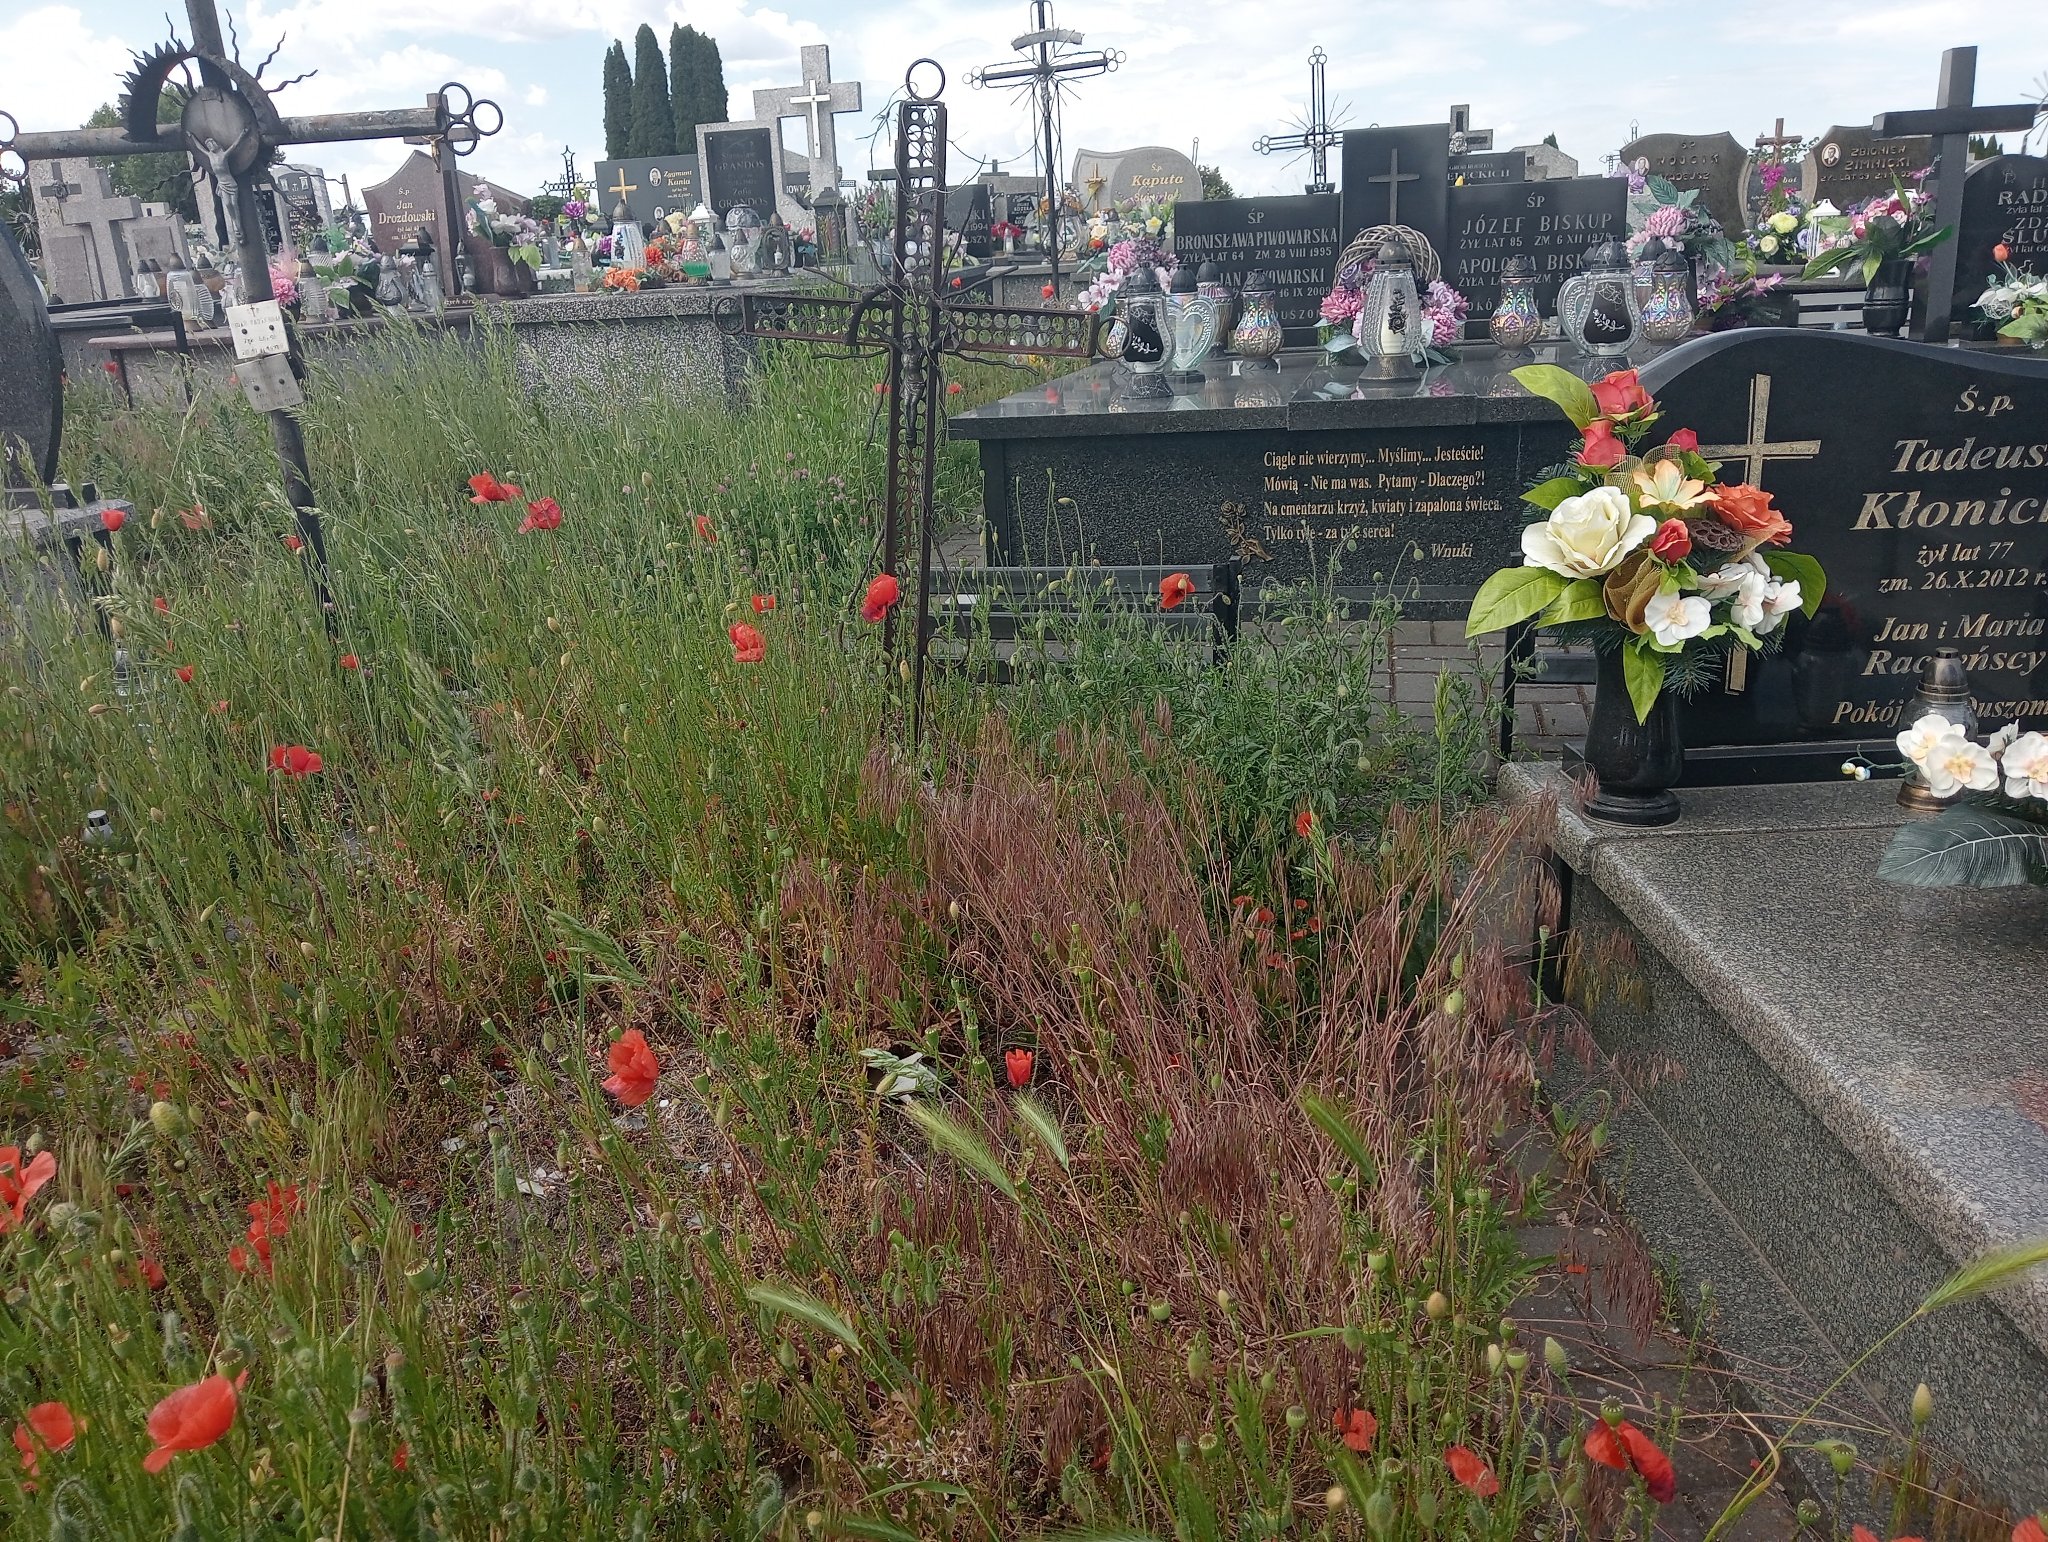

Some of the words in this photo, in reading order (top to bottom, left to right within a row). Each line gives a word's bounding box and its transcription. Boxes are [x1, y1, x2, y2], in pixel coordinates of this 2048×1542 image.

[1131, 174, 1184, 188] Kaputa
[396, 201, 413, 210] Jan
[378, 209, 436, 225] Drozdowski
[1462, 213, 1526, 236] JÓZEF
[1540, 212, 1613, 232] BISKUP
[1176, 232, 1255, 250] BRONISŁAWA
[1256, 228, 1338, 247] PIWOWARSKA
[1485, 237, 1506, 248] LAT
[1534, 235, 1551, 246] ZM
[1567, 234, 1583, 245] XII
[1210, 251, 1228, 262] LAT
[1232, 250, 1244, 261] 64
[1255, 250, 1270, 260] ZM
[1274, 249, 1286, 259] 28
[1289, 247, 1306, 258] VIII
[1310, 246, 1333, 257] 1995
[1458, 255, 1537, 275] APOLOA
[1219, 271, 1243, 288] JAN
[1293, 287, 1304, 297] IX
[1263, 451, 1297, 470] Ciągle
[1299, 450, 1315, 466] nie
[1317, 449, 1375, 468] wierzymy...
[1378, 446, 1432, 467] Myślimy...
[1434, 444, 1484, 462] Jesteście!
[1890, 436, 2048, 473] Tadeus
[1263, 475, 1299, 495] Mówią
[1310, 474, 1329, 490] Nie
[1331, 477, 1347, 490] ma
[1349, 477, 1372, 490] was.
[1378, 473, 1418, 492] Pytamy
[1428, 470, 1485, 491] Dlaczego?!
[1264, 501, 1278, 516] Na
[1280, 502, 1335, 516] cmentarzu
[1337, 499, 1369, 518] krzyż,
[1371, 498, 1406, 517] kwiaty
[1408, 497, 1413, 512] i
[1415, 497, 1463, 517] zapalona
[1465, 496, 1503, 512] świeca.
[1264, 525, 1294, 544] Tylko
[1325, 528, 1338, 539] za
[1362, 523, 1395, 539] serca!
[1431, 542, 1474, 558] Wnuki
[1916, 544, 1949, 568] żył
[1951, 543, 1981, 562] lat
[1988, 541, 2014, 560] 77
[1877, 577, 1913, 594] zm.
[1921, 567, 2029, 590] 26.X.2012
[2034, 572, 2048, 586] r.
[1873, 616, 1929, 642] Jan
[1937, 620, 1948, 639] i
[1953, 612, 2046, 640] Maria
[1861, 644, 2047, 677] Racńscy
[1831, 699, 1904, 729] Pokój
